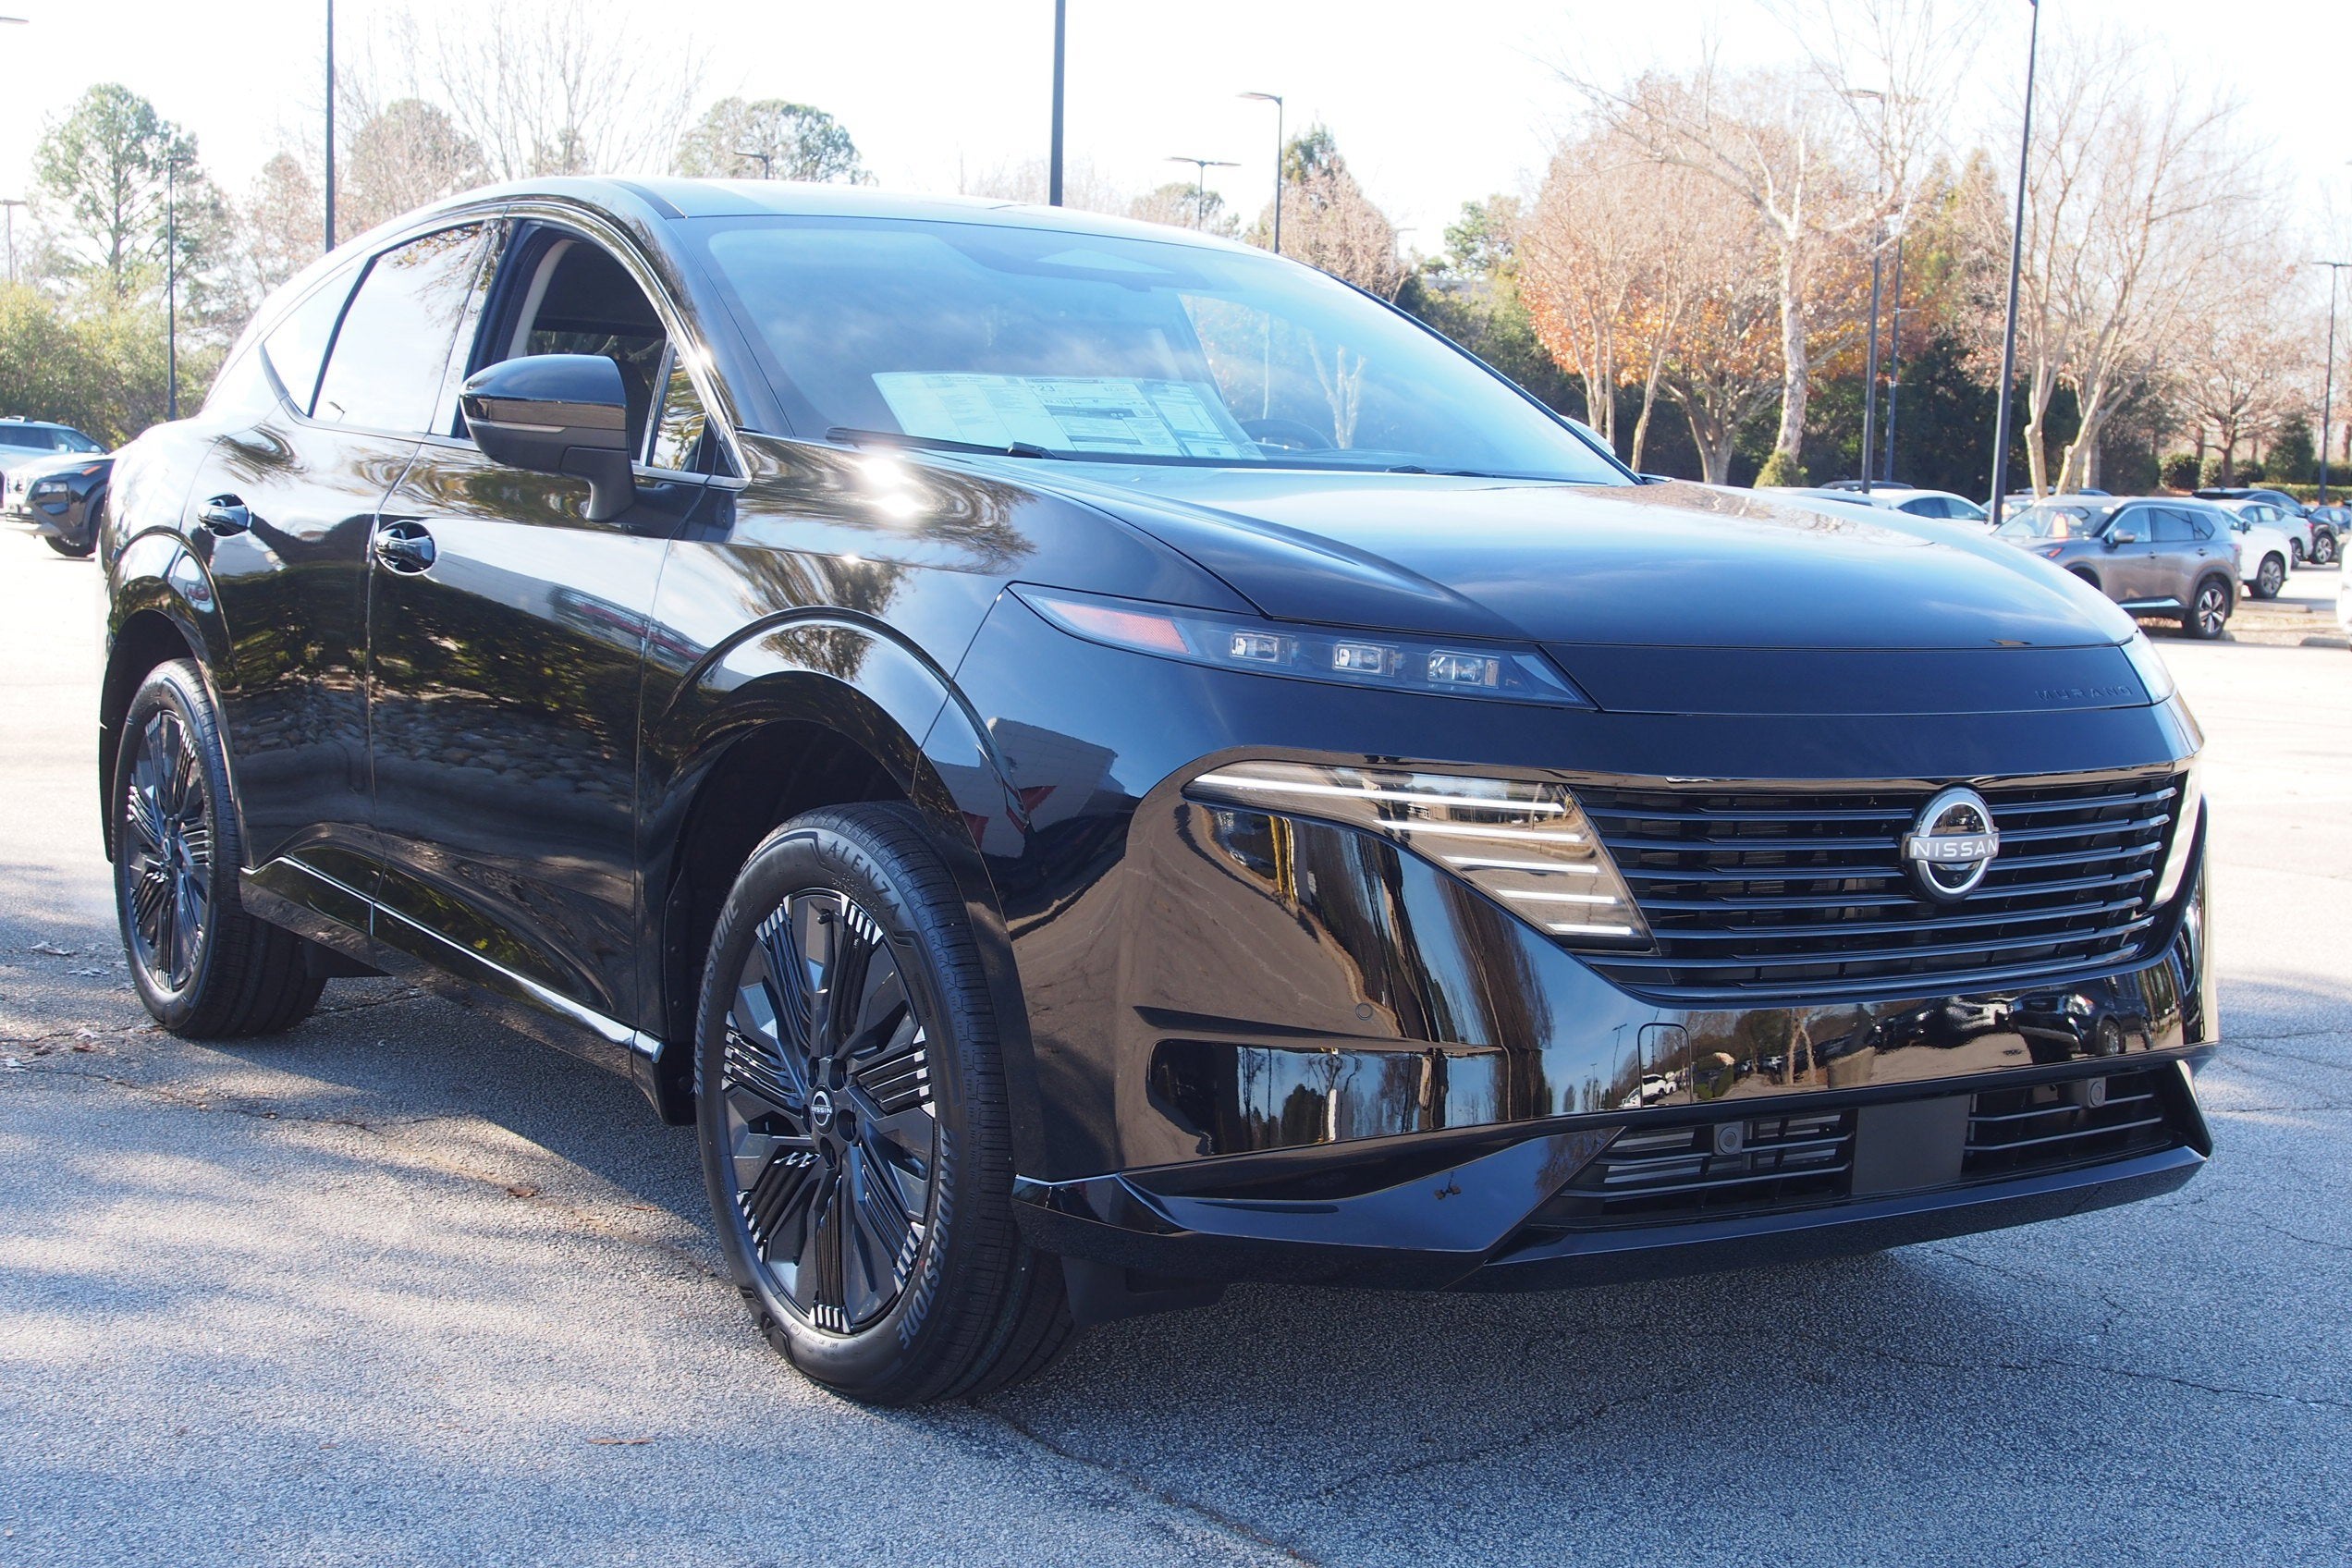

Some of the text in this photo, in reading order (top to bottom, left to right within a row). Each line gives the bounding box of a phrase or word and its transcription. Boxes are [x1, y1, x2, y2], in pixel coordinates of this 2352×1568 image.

[2034, 684, 2133, 703] MURANO
[1912, 837, 1999, 858] NISSAN
[827, 839, 900, 922] ALENZA
[895, 1122, 960, 1351] BRIDGESTONE
